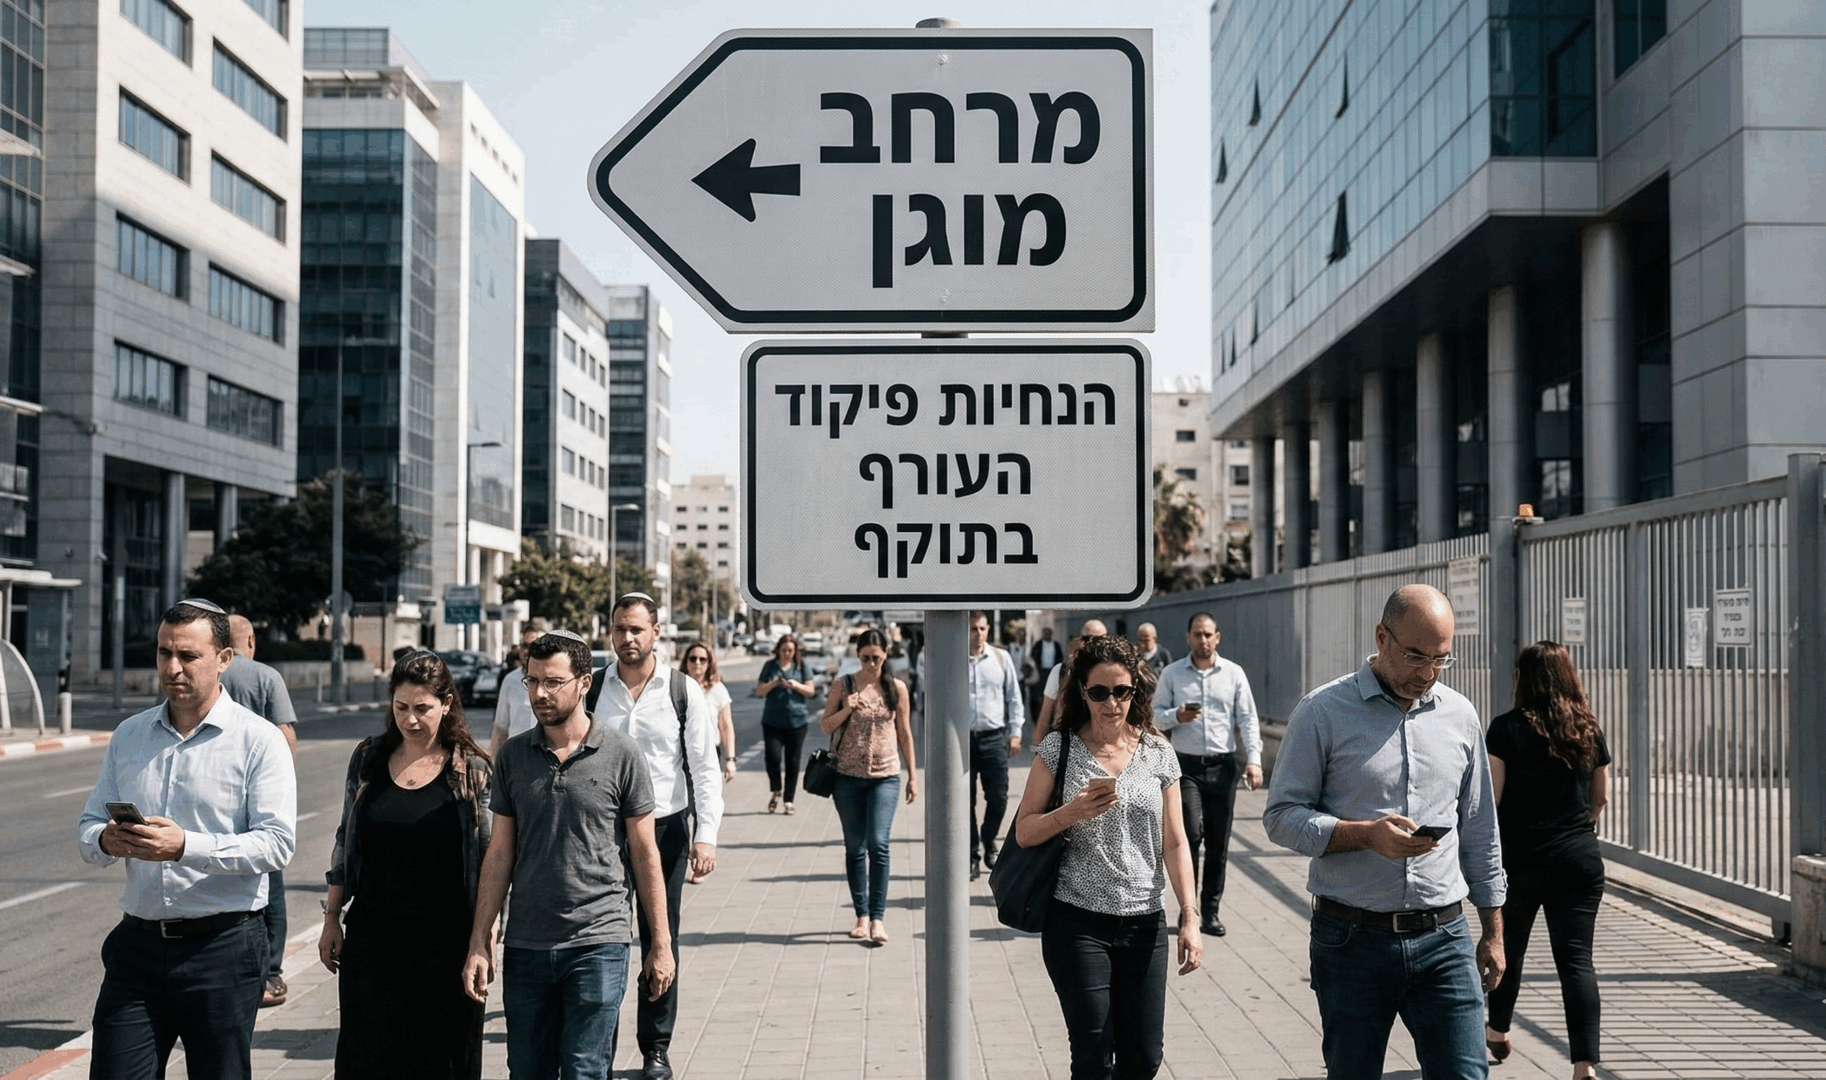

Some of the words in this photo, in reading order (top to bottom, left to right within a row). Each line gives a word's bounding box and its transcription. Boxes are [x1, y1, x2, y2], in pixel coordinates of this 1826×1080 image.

[820, 92, 1100, 164] מרחב
[873, 193, 1066, 288] מוגן
[775, 384, 918, 439] פיקוד
[939, 383, 1115, 425] הנחיות
[860, 453, 1030, 509] העורף
[855, 523, 1038, 578] בתוקף
